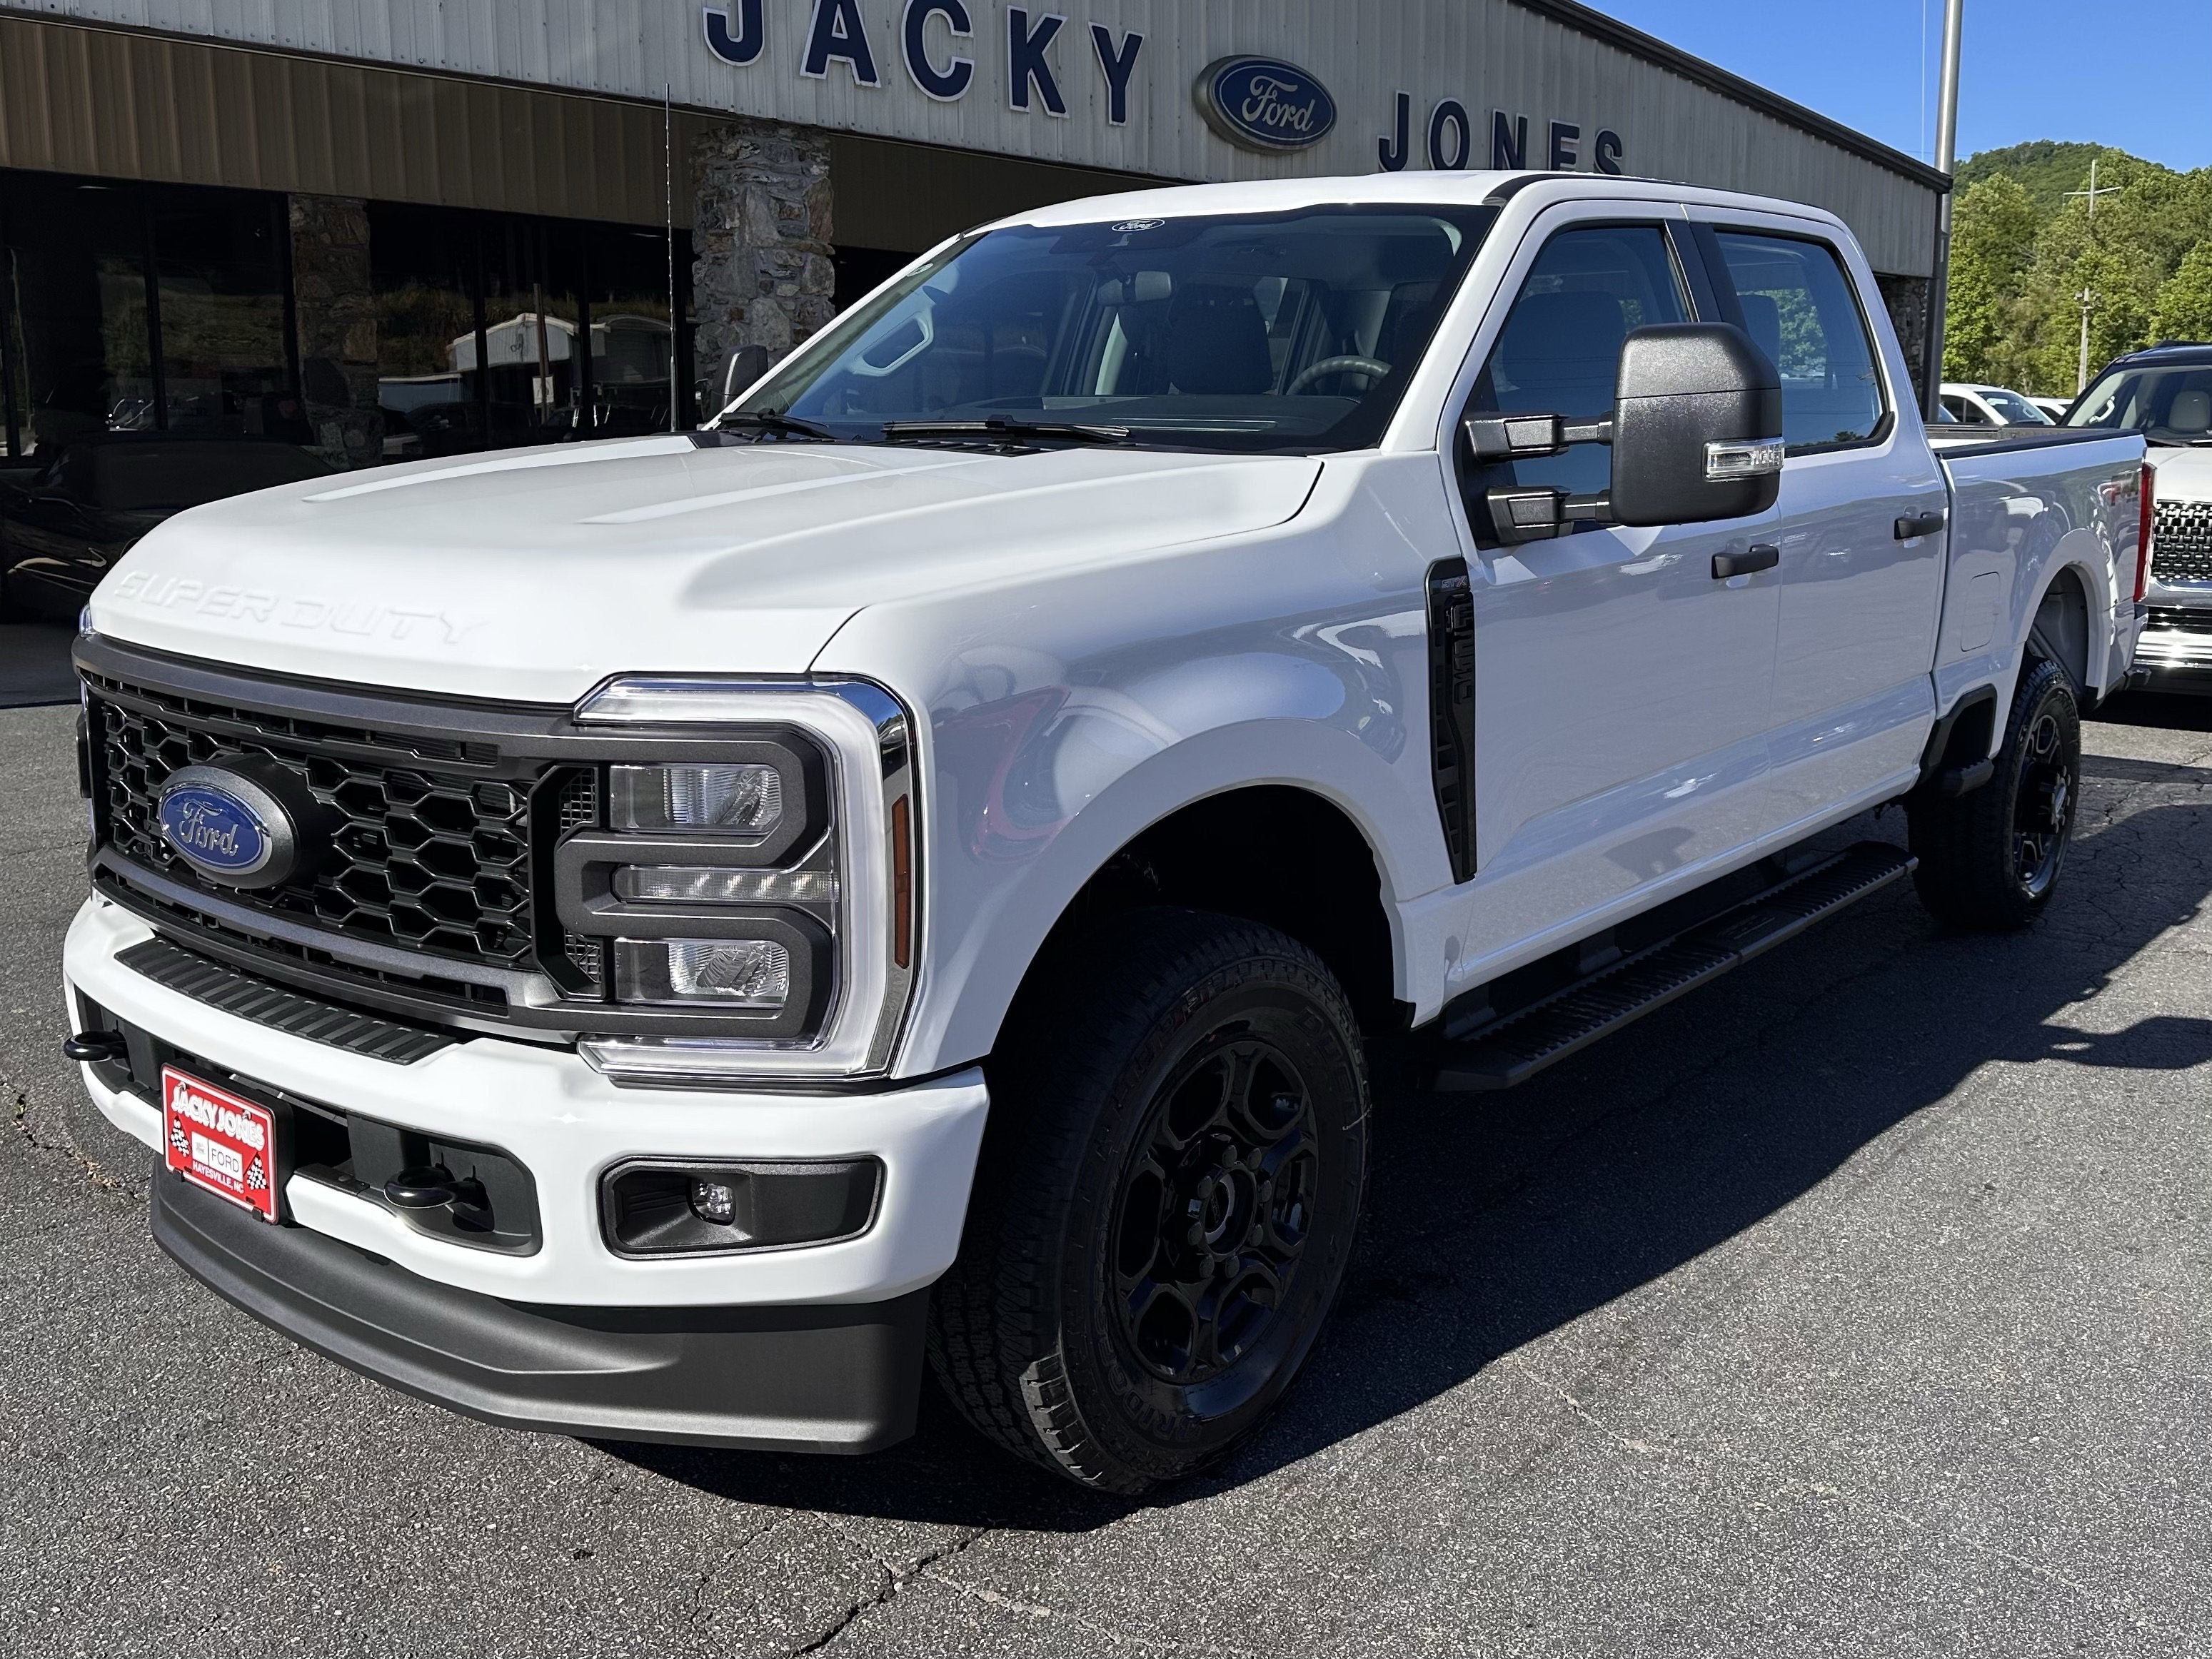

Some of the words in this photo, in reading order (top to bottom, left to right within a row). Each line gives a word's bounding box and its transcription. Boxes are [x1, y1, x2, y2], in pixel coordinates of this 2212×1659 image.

[703, 0, 1145, 127] JACKY
[1377, 91, 1624, 175] JONES
[1241, 74, 1315, 133] Ford
[114, 570, 280, 623] SUPER
[281, 600, 491, 645] DUTY
[179, 797, 238, 857] Ford
[171, 1084, 218, 1130] JACKY
[216, 1106, 266, 1152] JONES
[192, 1161, 233, 1191] HAYESVILLE,
[231, 1181, 245, 1195] NC
[211, 1148, 240, 1174] FORD
